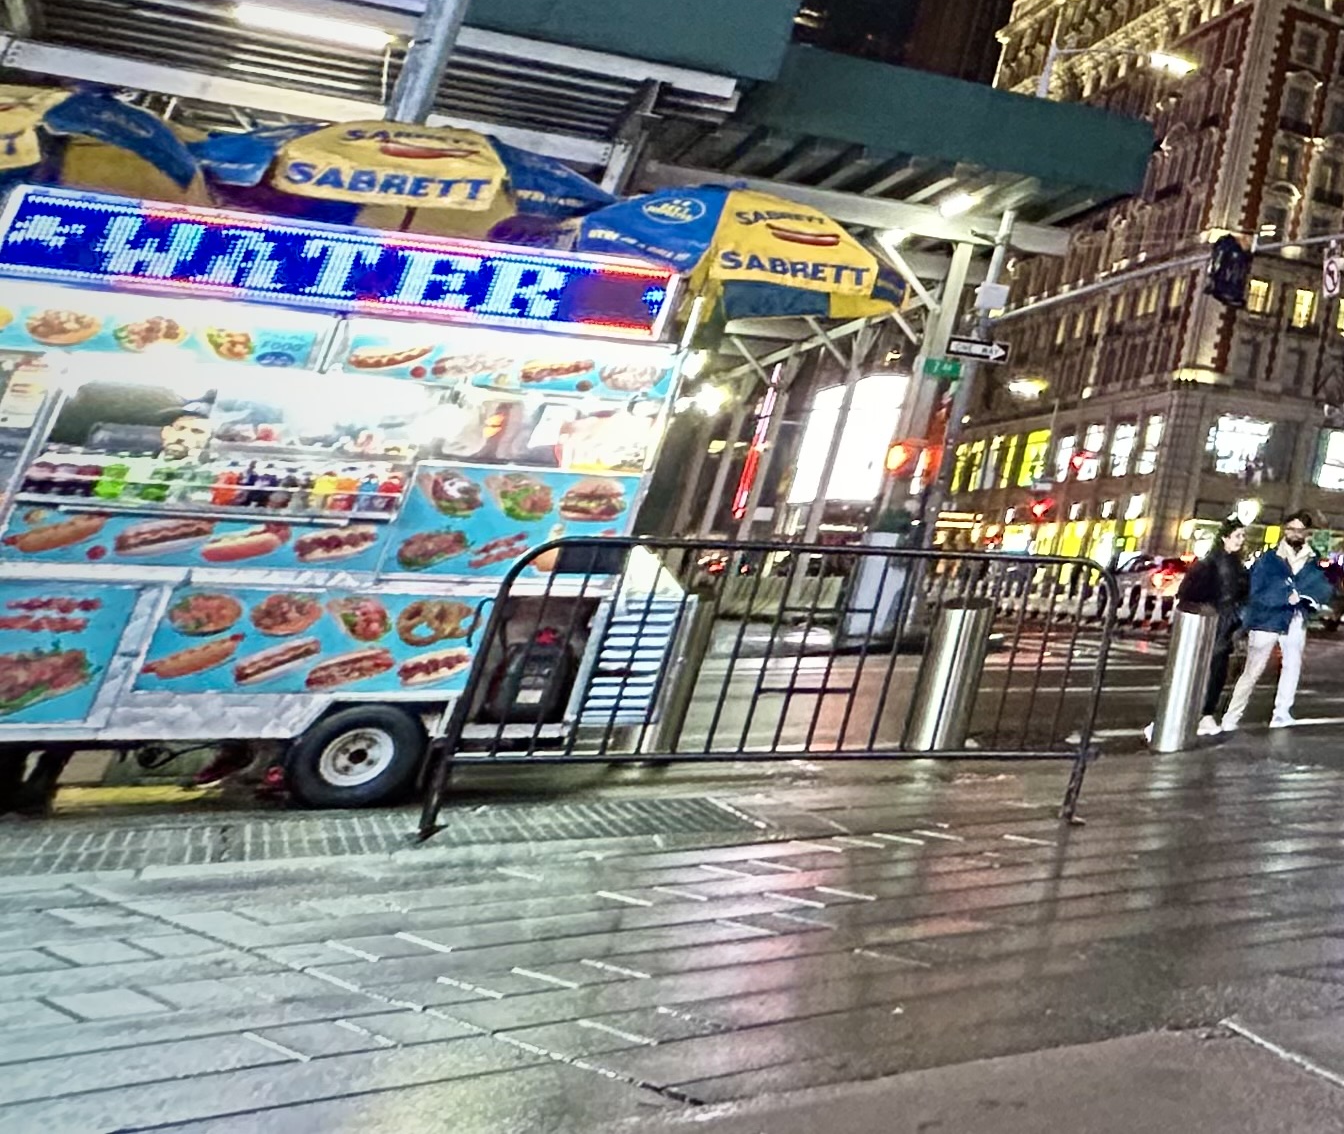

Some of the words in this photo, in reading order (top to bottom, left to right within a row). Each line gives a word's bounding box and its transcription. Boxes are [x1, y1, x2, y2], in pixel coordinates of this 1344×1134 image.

[285, 161, 492, 200] SABRETT
[98, 213, 570, 323] WATER
[719, 250, 871, 288] SABRETT
[981, 346, 999, 355] WAY
